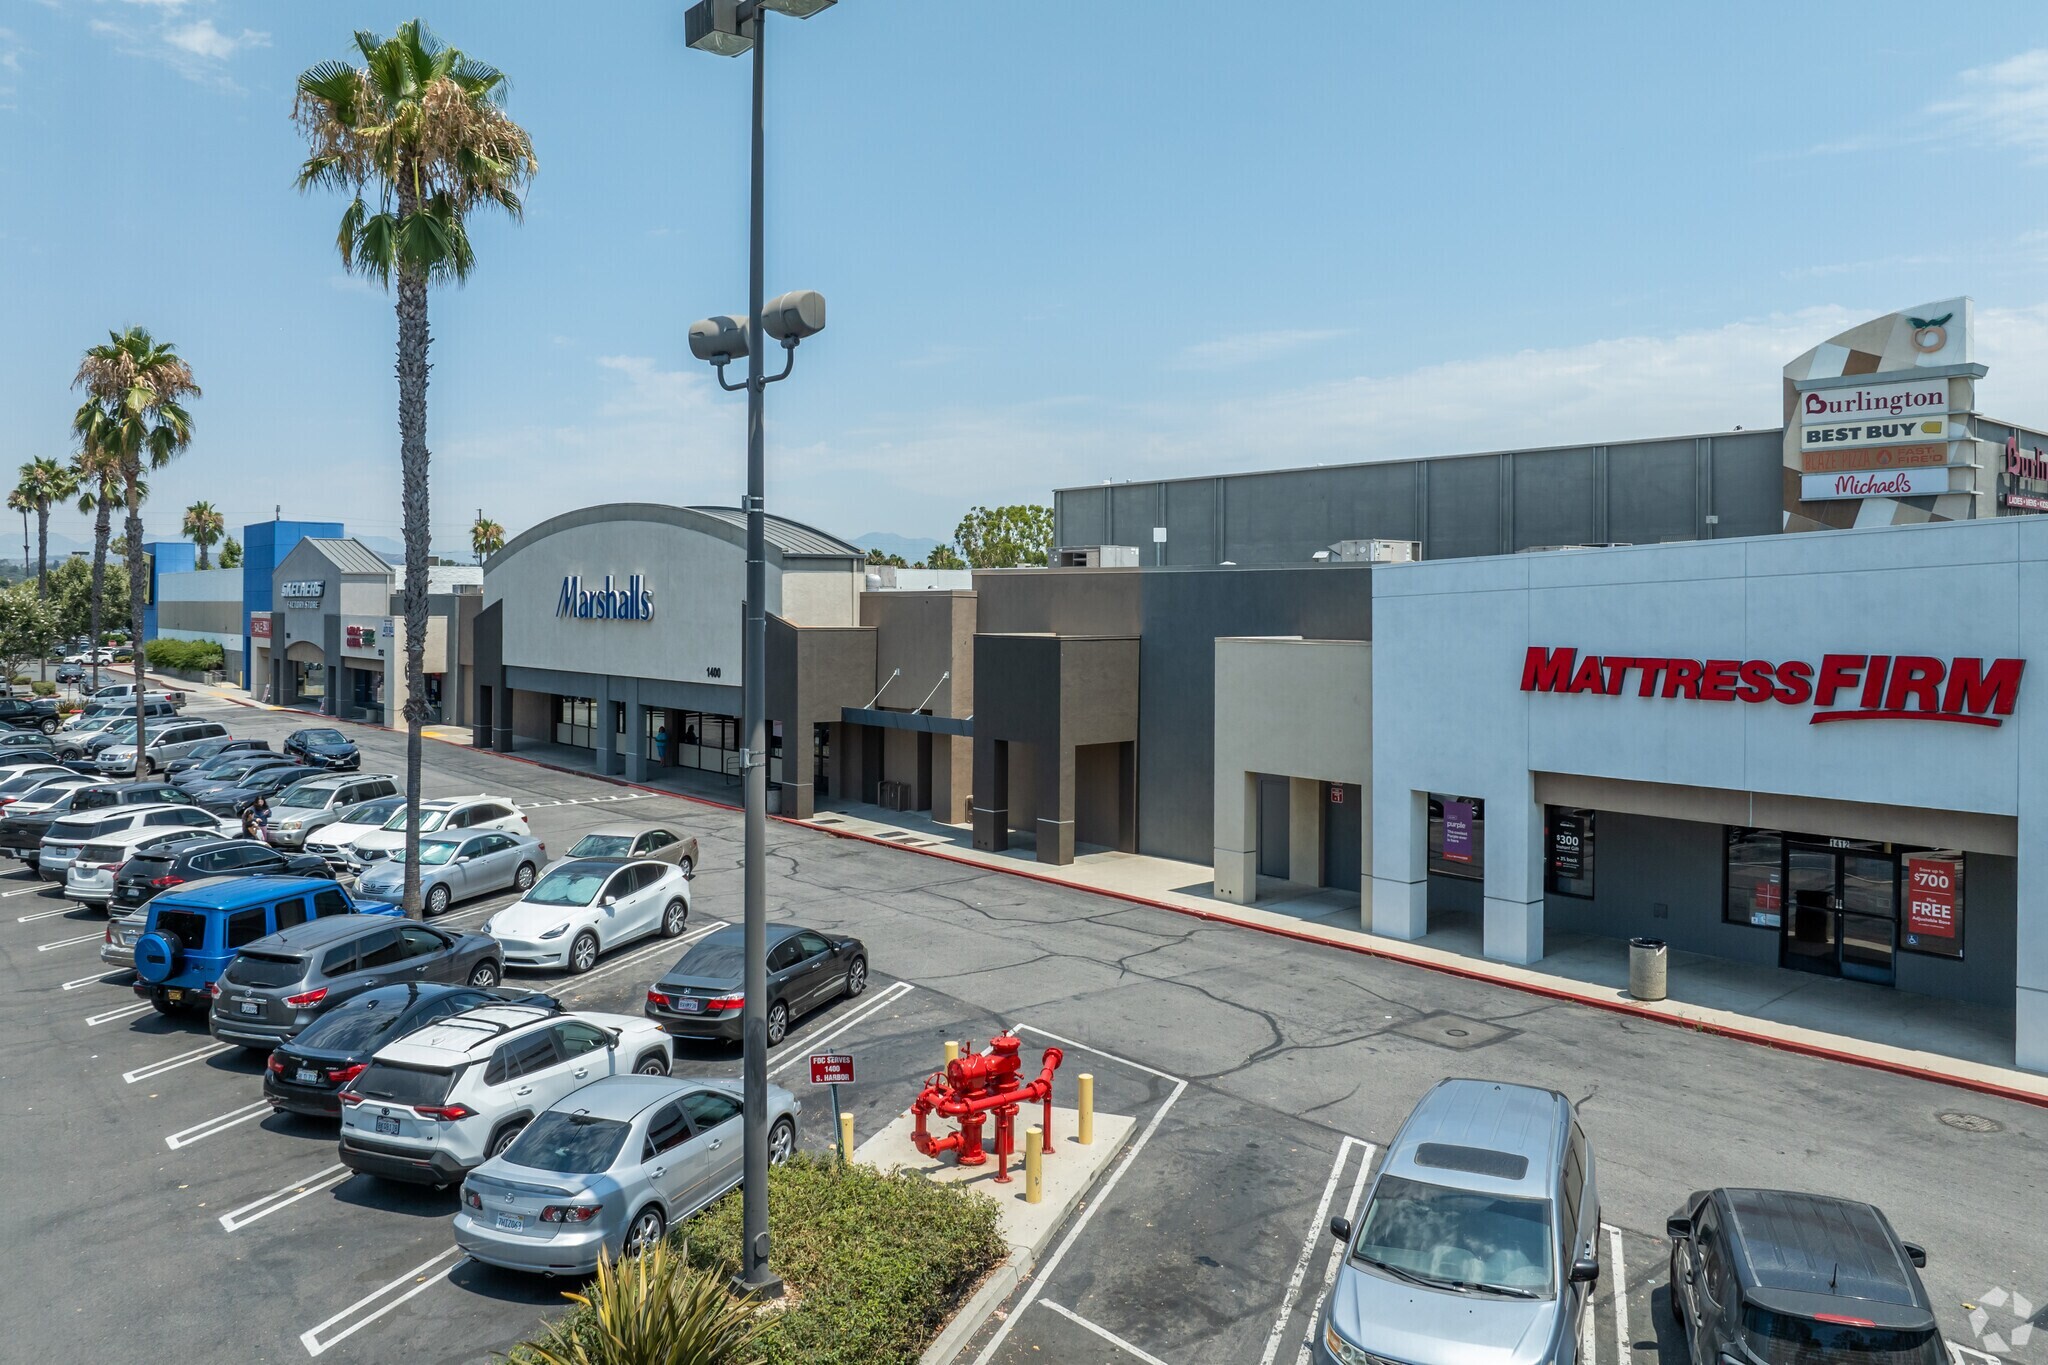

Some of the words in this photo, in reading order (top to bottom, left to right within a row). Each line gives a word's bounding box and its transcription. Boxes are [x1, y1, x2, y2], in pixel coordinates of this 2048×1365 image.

[1806, 391, 1944, 415] Burlington
[1807, 427, 1861, 443] BEST
[1866, 422, 1916, 439] BUY
[1805, 453, 1836, 471] BLAZE
[1842, 449, 1870, 468] PIZZA
[1835, 473, 1911, 495] Michaels
[281, 581, 325, 598] SKECHERS
[304, 600, 320, 609] STORE
[556, 575, 654, 621] Marshalls
[707, 667, 721, 678] 1400
[1520, 646, 1811, 704] MATTRESS
[1814, 654, 2026, 716] FIRM
[1446, 821, 1466, 829] purple
[1556, 834, 1579, 846] $300
[1829, 838, 1850, 849] 1412
[1914, 873, 1949, 889] $700
[1912, 901, 1952, 919] FREE
[813, 1057, 826, 1065] FDC
[826, 1056, 851, 1064] SERVES
[824, 1065, 841, 1073] 1400
[816, 1074, 823, 1082] S.
[823, 1073, 850, 1082] HARBOR
